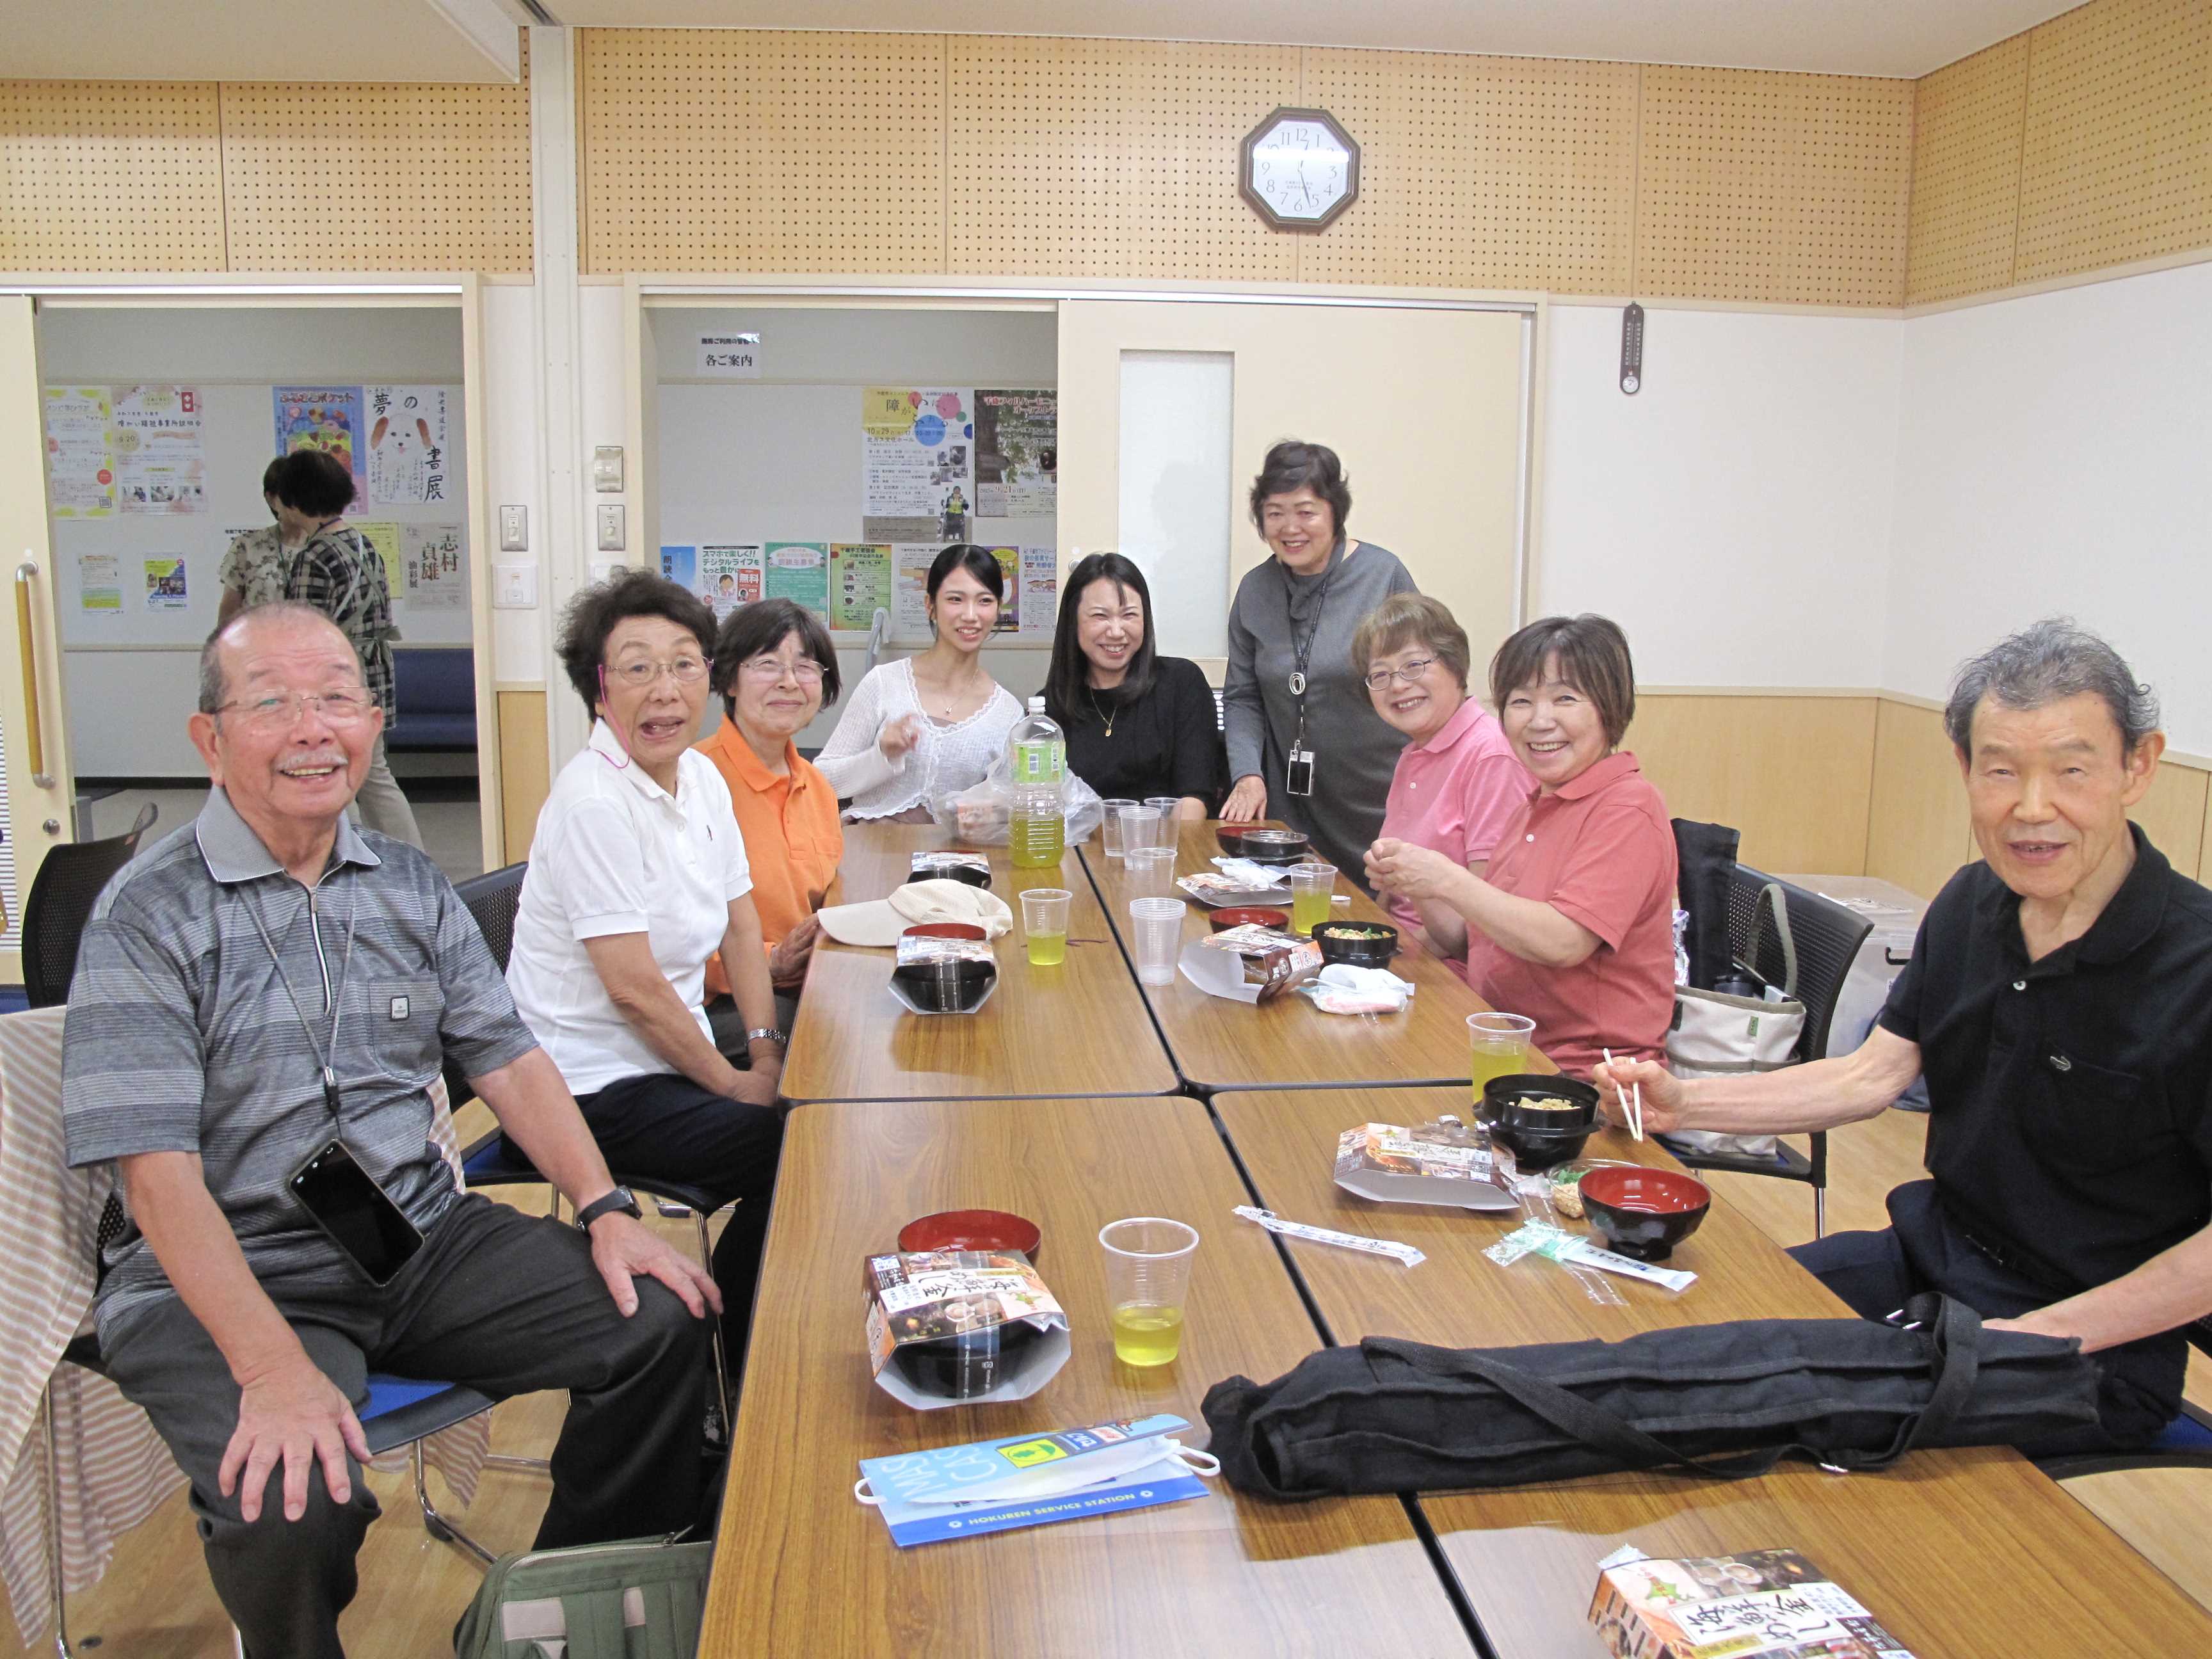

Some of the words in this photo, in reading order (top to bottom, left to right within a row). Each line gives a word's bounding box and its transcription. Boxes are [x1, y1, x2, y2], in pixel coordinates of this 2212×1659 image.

[1281, 132, 1290, 145] 11
[1296, 129, 1308, 141] 12
[1317, 134, 1320, 147] 1
[1262, 162, 1270, 175] 9
[1329, 166, 1337, 179] 3
[1266, 180, 1275, 193] 8
[1324, 184, 1333, 196] 4
[1280, 193, 1288, 205] 7
[1294, 199, 1302, 211] 6
[1311, 195, 1319, 207] 5
[706, 355, 752, 366] 各ご案内
[374, 393, 418, 415] 夢の
[424, 445, 444, 502] 書展
[421, 542, 440, 581] 貞雄
[968, 1510, 1031, 1525] HOKUREN
[1034, 1502, 1082, 1516] SERVICE
[1085, 1493, 1135, 1507] STATION
[1687, 1593, 1815, 1635] 海鮮釜
[1762, 1619, 1831, 1640] めし
